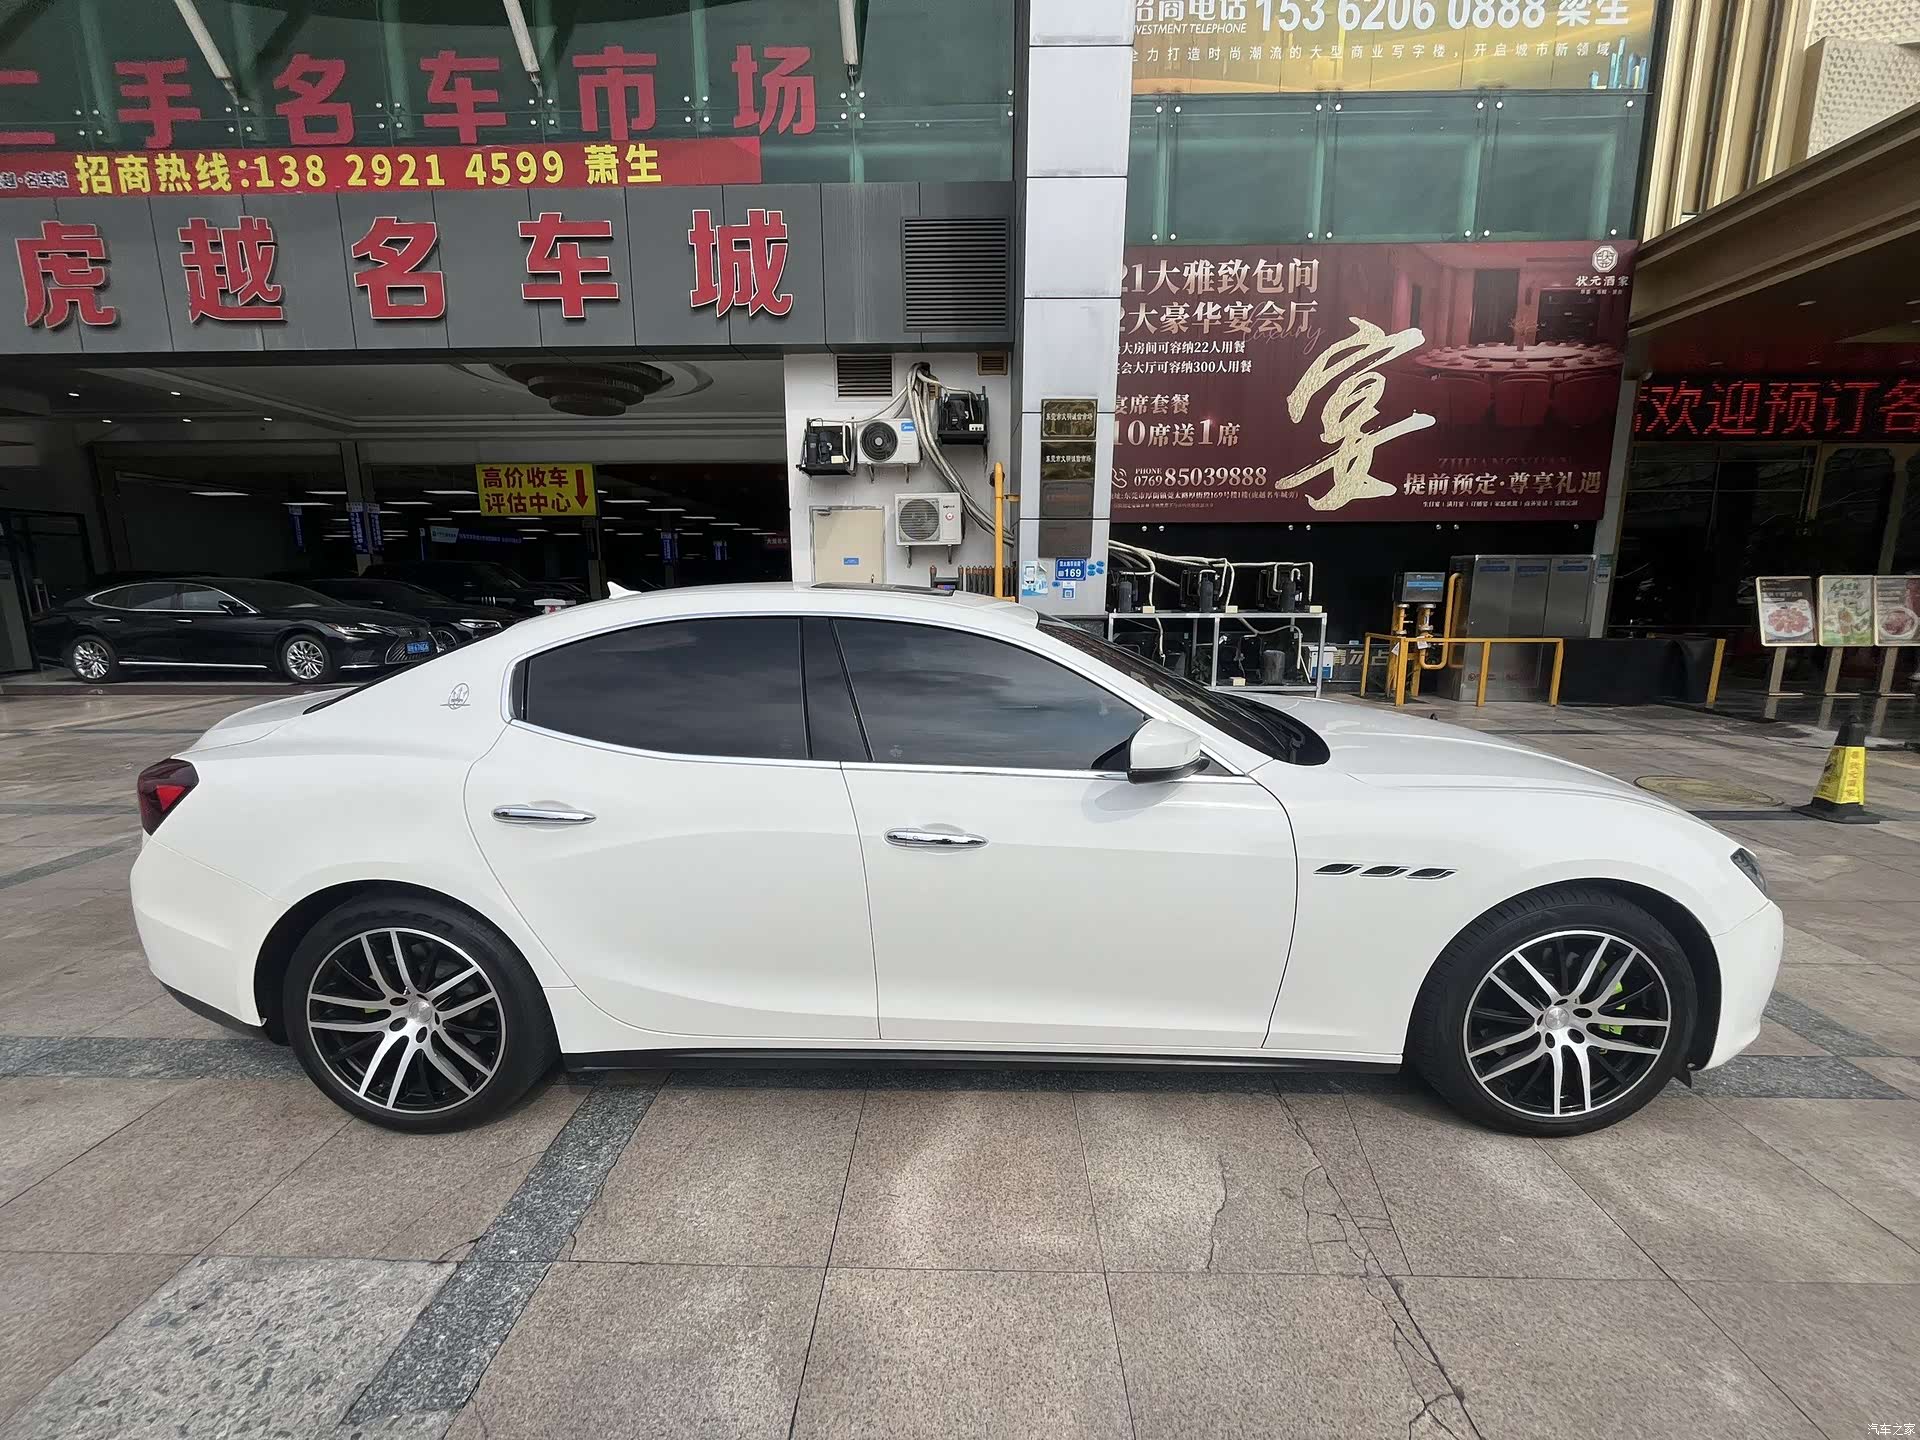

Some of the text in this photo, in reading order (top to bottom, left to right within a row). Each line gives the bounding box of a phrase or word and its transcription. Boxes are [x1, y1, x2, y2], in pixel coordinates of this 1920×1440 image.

[1256, 0, 1325, 31] 153
[1338, 0, 1435, 31] 6206
[1448, 0, 1545, 29] 0888
[1135, 23, 1247, 35] VESTMENT TELEPHONE
[0, 43, 816, 148] 二手名车市场
[346, 154, 445, 187] 2921
[465, 151, 564, 185] 4599
[585, 143, 662, 185] 萧生
[15, 208, 794, 329] 虎越名车城
[1575, 275, 1630, 287] 状元酒家
[1117, 340, 1246, 355] 大房间可容纳22人用餐
[1116, 360, 1252, 375] 会大厅可容纳300人用餐
[1633, 379, 1920, 434] 欢迎预订各
[482, 467, 569, 489] 高价收车
[1134, 466, 1268, 487] 0769 85039888
[1403, 471, 1602, 496] 提前预定·尊享礼遇
[485, 492, 571, 513] 评估中心
[1064, 568, 1082, 578] 169
